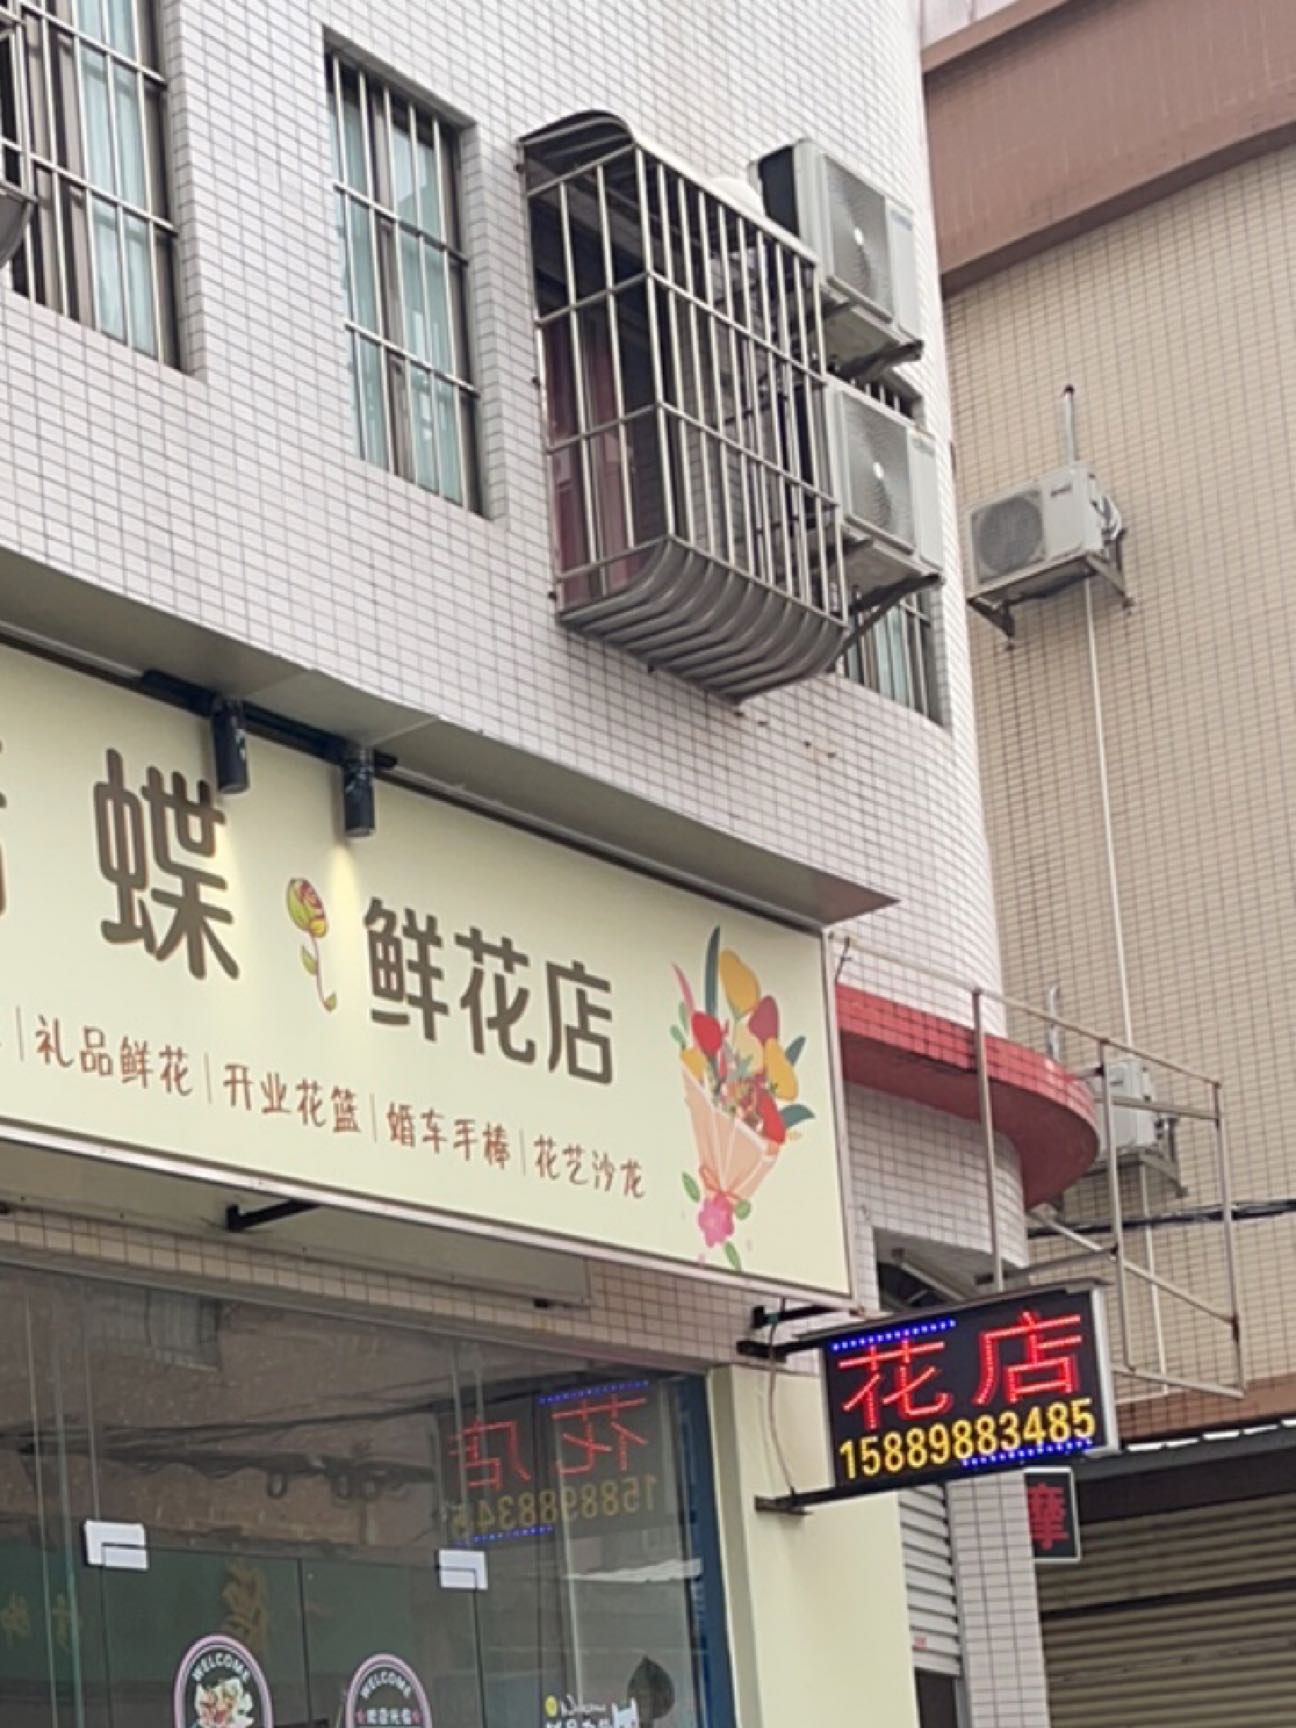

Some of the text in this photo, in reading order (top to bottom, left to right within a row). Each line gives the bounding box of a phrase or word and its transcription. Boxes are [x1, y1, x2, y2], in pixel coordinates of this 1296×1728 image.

[364, 896, 613, 1086] 鲜花店
[35, 1014, 194, 1098] 礼品鲜花
[223, 1064, 361, 1134] 开业花篮
[837, 1309, 1084, 1430] 花店
[838, 1397, 1096, 1480] 15889883485
[192, 1652, 251, 1682] WELCOME
[360, 1671, 411, 1698] WELCOME
